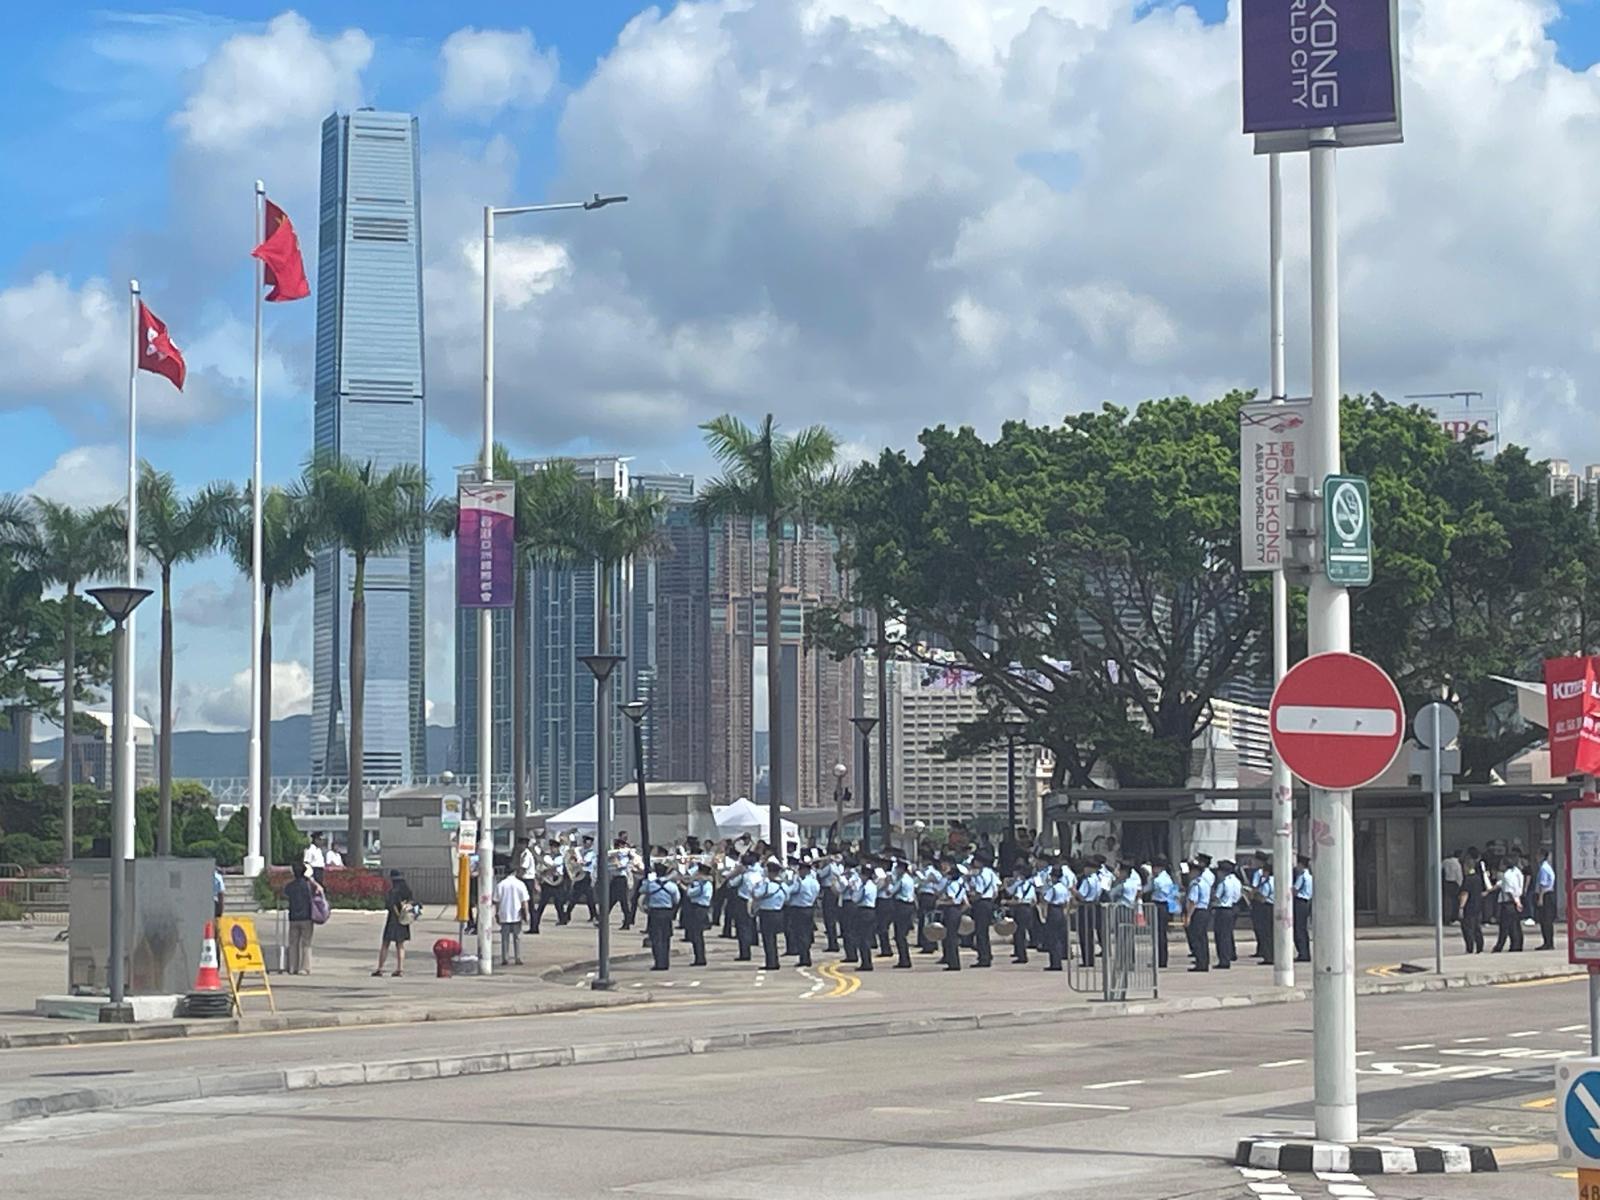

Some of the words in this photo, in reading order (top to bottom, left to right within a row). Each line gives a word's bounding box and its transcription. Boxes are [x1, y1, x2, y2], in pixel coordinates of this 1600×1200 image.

[1291, 49, 1308, 109] CITY
[1265, 441, 1280, 500] HONG
[1256, 486, 1265, 531] WORLD
[1266, 505, 1281, 564] KONG
[1256, 533, 1265, 563] CITY
